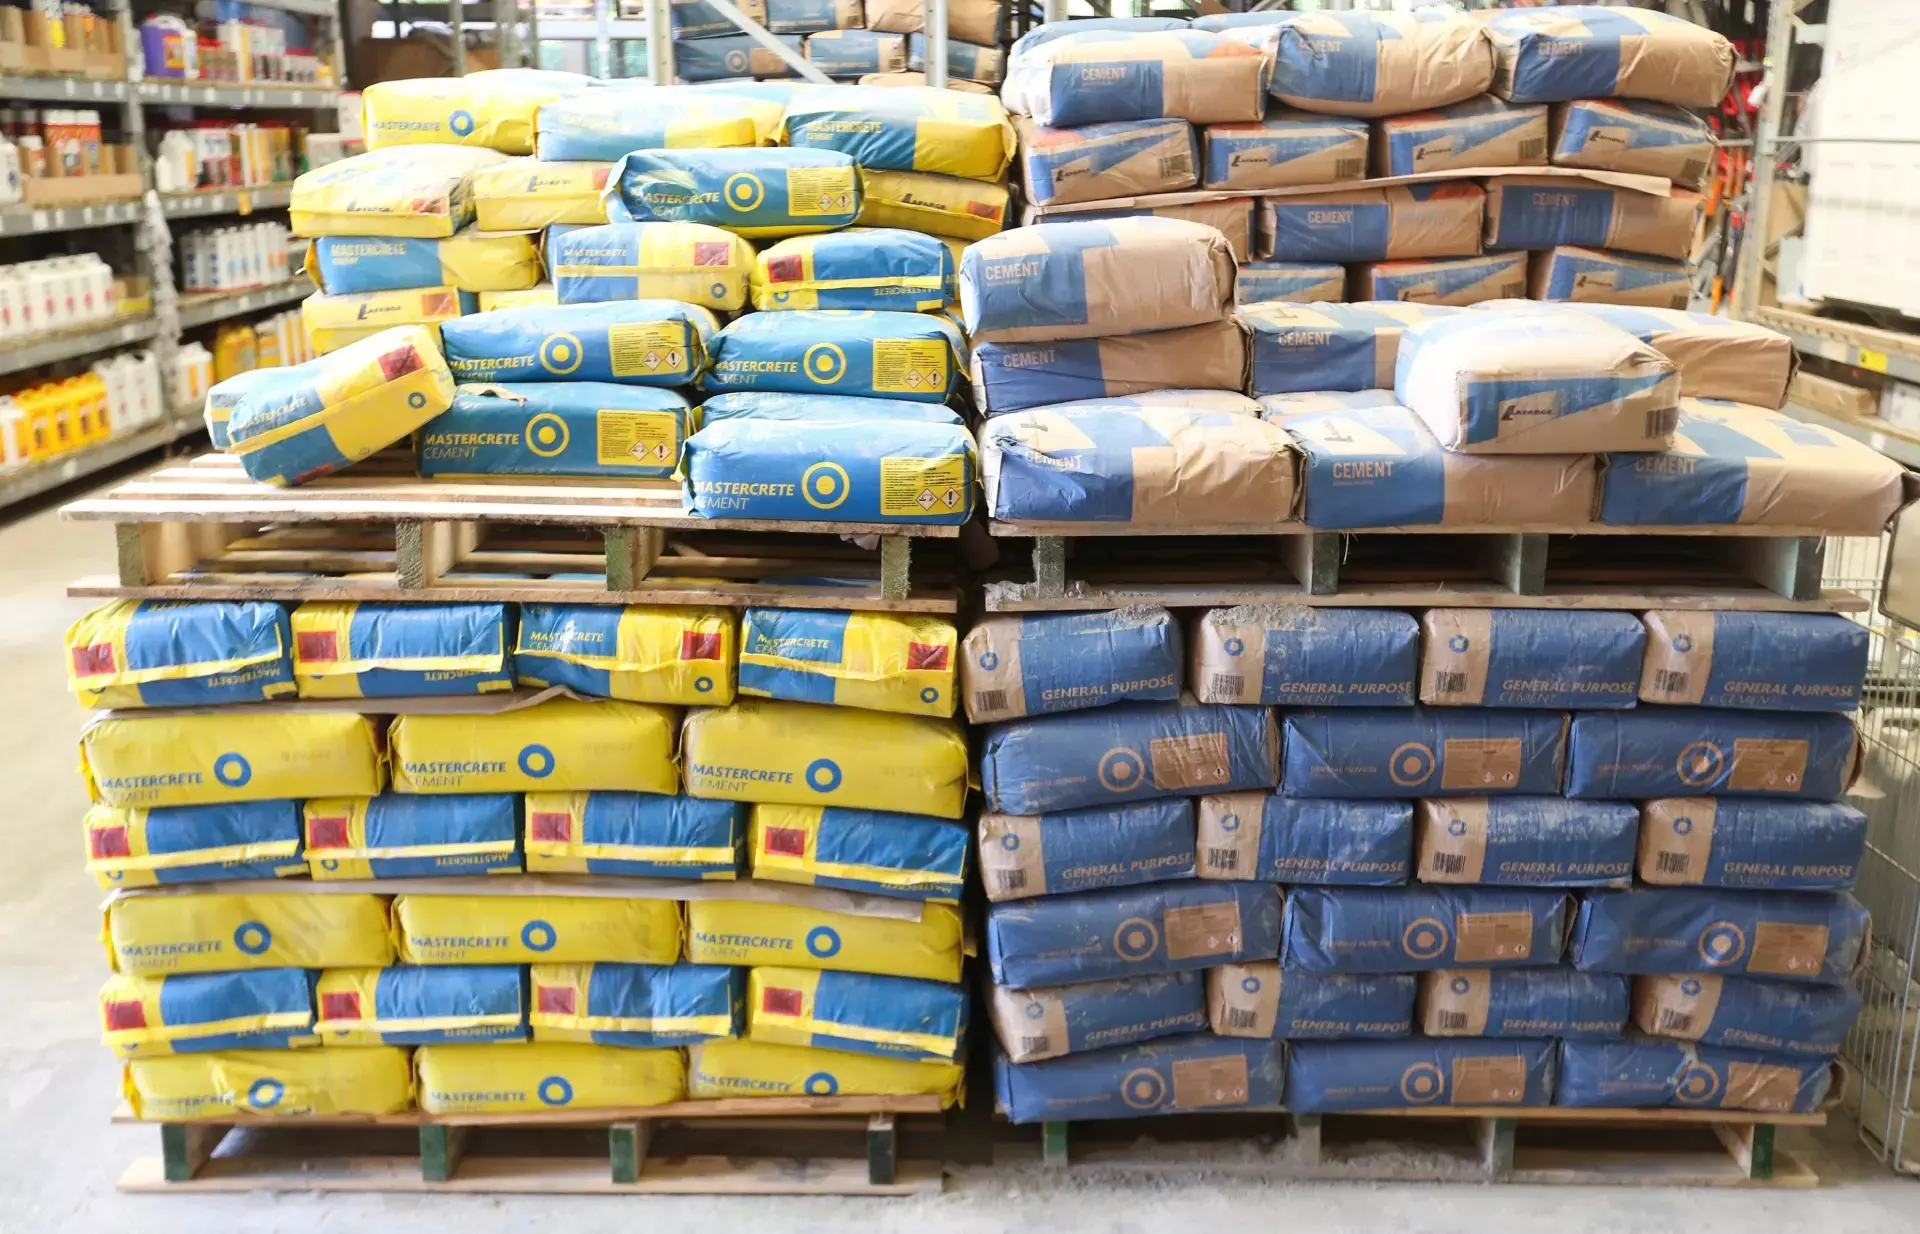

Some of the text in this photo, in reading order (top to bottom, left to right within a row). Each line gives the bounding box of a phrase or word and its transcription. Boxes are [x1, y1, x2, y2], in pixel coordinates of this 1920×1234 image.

[1081, 67, 1127, 81] CEMENT
[1307, 210, 1353, 224] CEMENT
[985, 262, 1040, 281] CEMENT
[1003, 350, 1057, 368] CEMENT
[425, 434, 519, 446] MASTERCRETE
[424, 446, 478, 460] CEMENT
[1333, 461, 1394, 479] CEMENT
[1635, 457, 1697, 474] CEMENT
[695, 481, 795, 497] MASTERCRETE
[1041, 674, 1175, 701] GENERAL PURPOSE
[1279, 682, 1413, 694] GENERAL PURPOSE
[1502, 679, 1636, 695] GENERAL PURPOSE
[1723, 682, 1856, 698] GENERAL PURPOSE
[406, 761, 507, 774] MASTERCRETE
[692, 763, 793, 784] MASTERCRETE
[101, 772, 204, 789] MASTERCRETE
[1062, 853, 1191, 879] GENERAL PURPOSE
[1274, 857, 1405, 873] GENERAL PURPOSE
[1500, 861, 1630, 875] GENERAL PURPOSE
[1724, 862, 1853, 878] GENERAL PURPOSE
[412, 936, 510, 948] MASTERCRETE
[696, 931, 794, 950] MASTERCRETE
[1084, 1021, 1147, 1042] GENERAL
